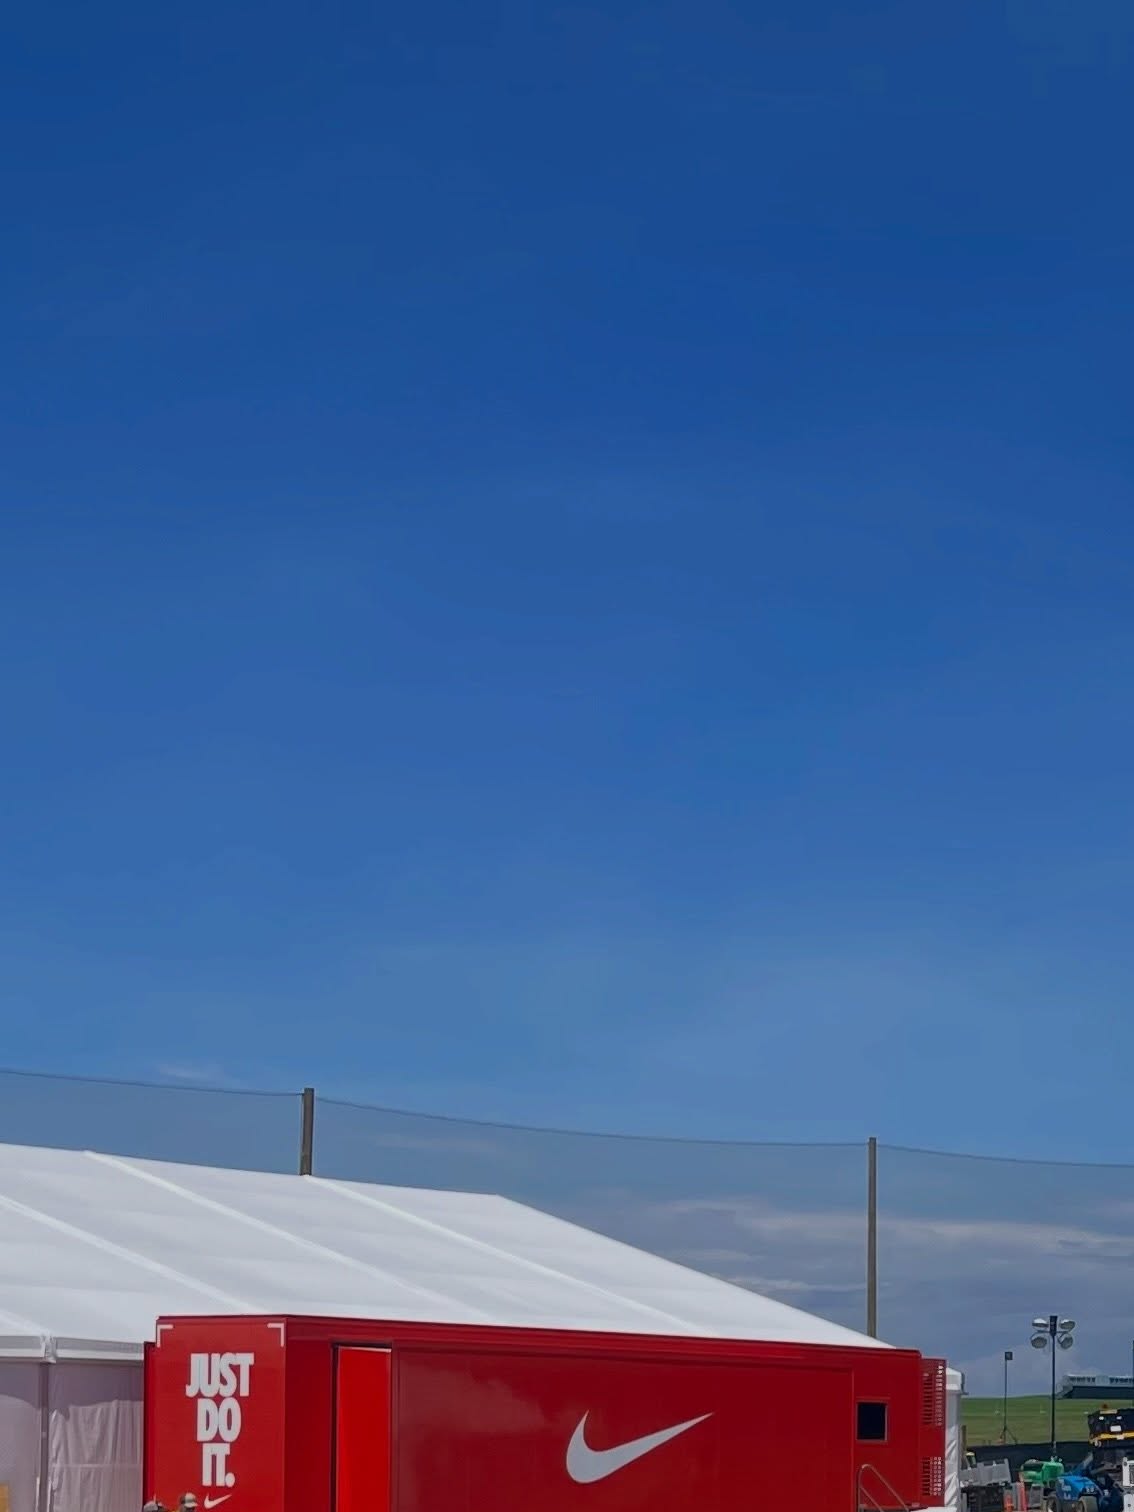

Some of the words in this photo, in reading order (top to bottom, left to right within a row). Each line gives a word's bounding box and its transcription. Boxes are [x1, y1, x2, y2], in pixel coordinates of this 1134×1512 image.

[185, 1352, 255, 1398] JUST
[196, 1397, 242, 1442] DO
[202, 1443, 235, 1487] IT.
